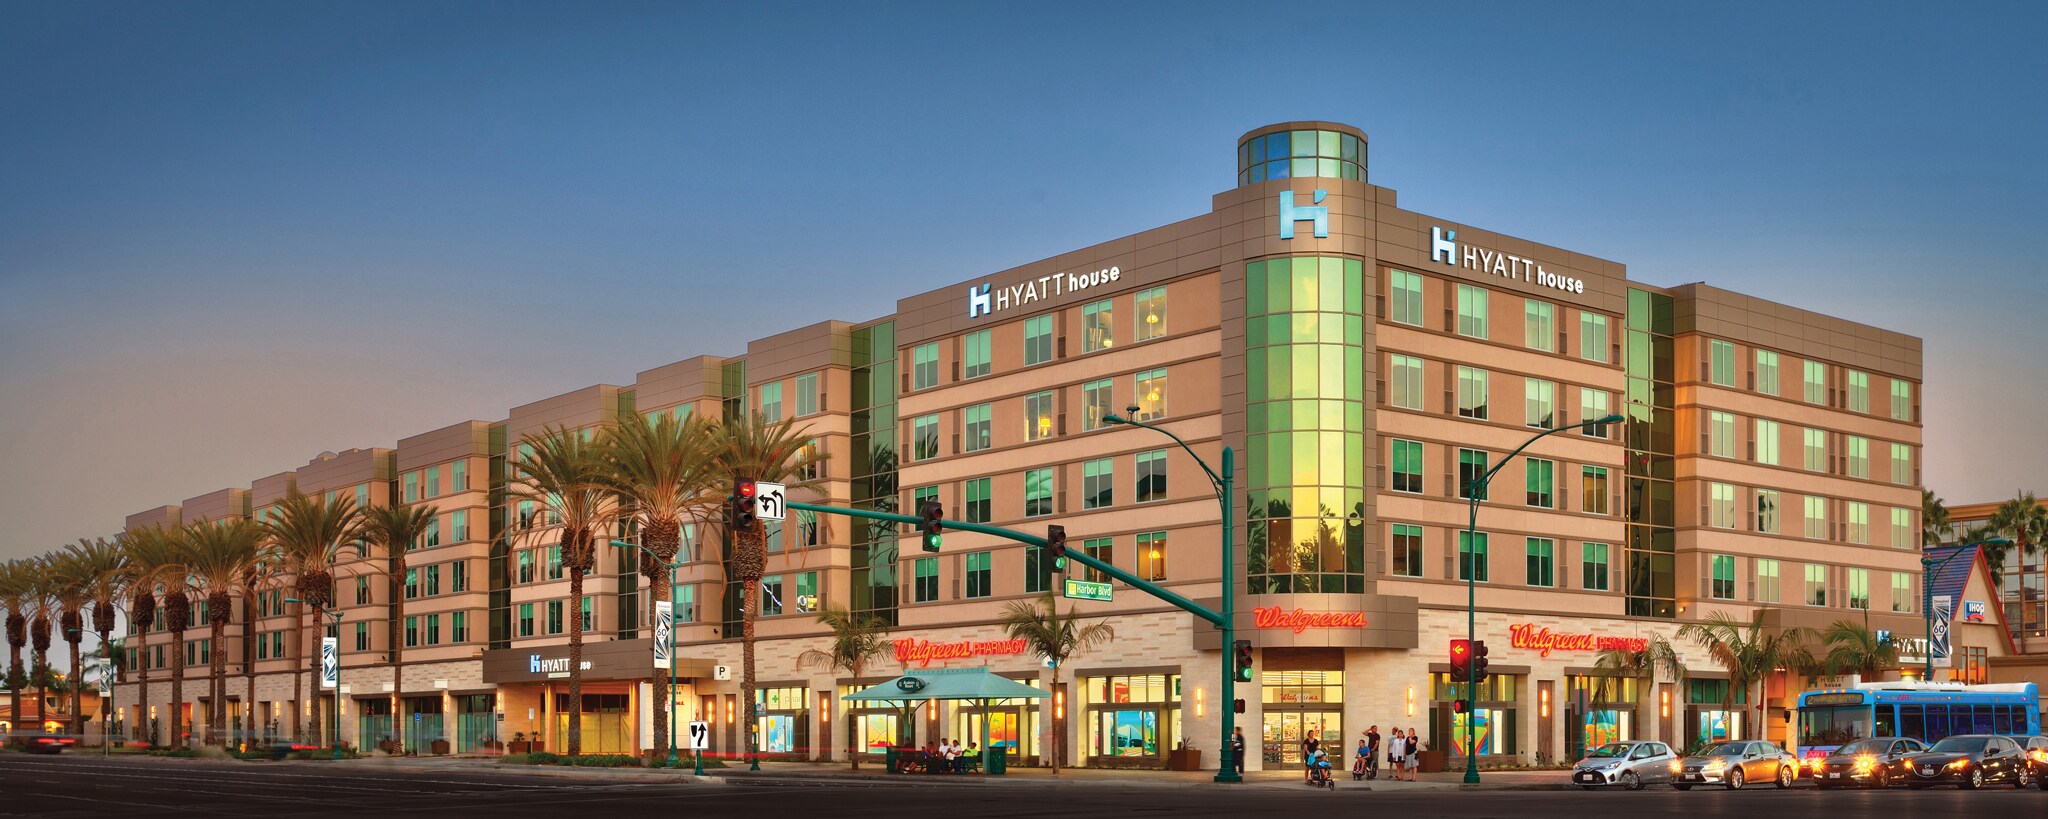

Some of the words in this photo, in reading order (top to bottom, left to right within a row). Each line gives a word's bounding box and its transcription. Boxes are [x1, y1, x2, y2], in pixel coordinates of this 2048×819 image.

[1463, 245, 1533, 282] HYATT
[1537, 265, 1583, 294] house
[997, 273, 1065, 311] HYATT
[1069, 266, 1120, 292] house
[1077, 584, 1097, 595] Harbor
[1098, 586, 1111, 597] Blvd
[1253, 606, 1367, 634] Walgreens
[657, 628, 667, 637] 60
[1934, 625, 1945, 634] 60
[1510, 623, 1596, 658] Walgreens
[1597, 635, 1648, 653] PHARMACY
[1892, 637, 1927, 654] HYATT
[894, 638, 972, 668] Walgreens
[973, 639, 1027, 655] PHARMACY
[541, 658, 570, 673] HYATT
[719, 666, 726, 676] P
